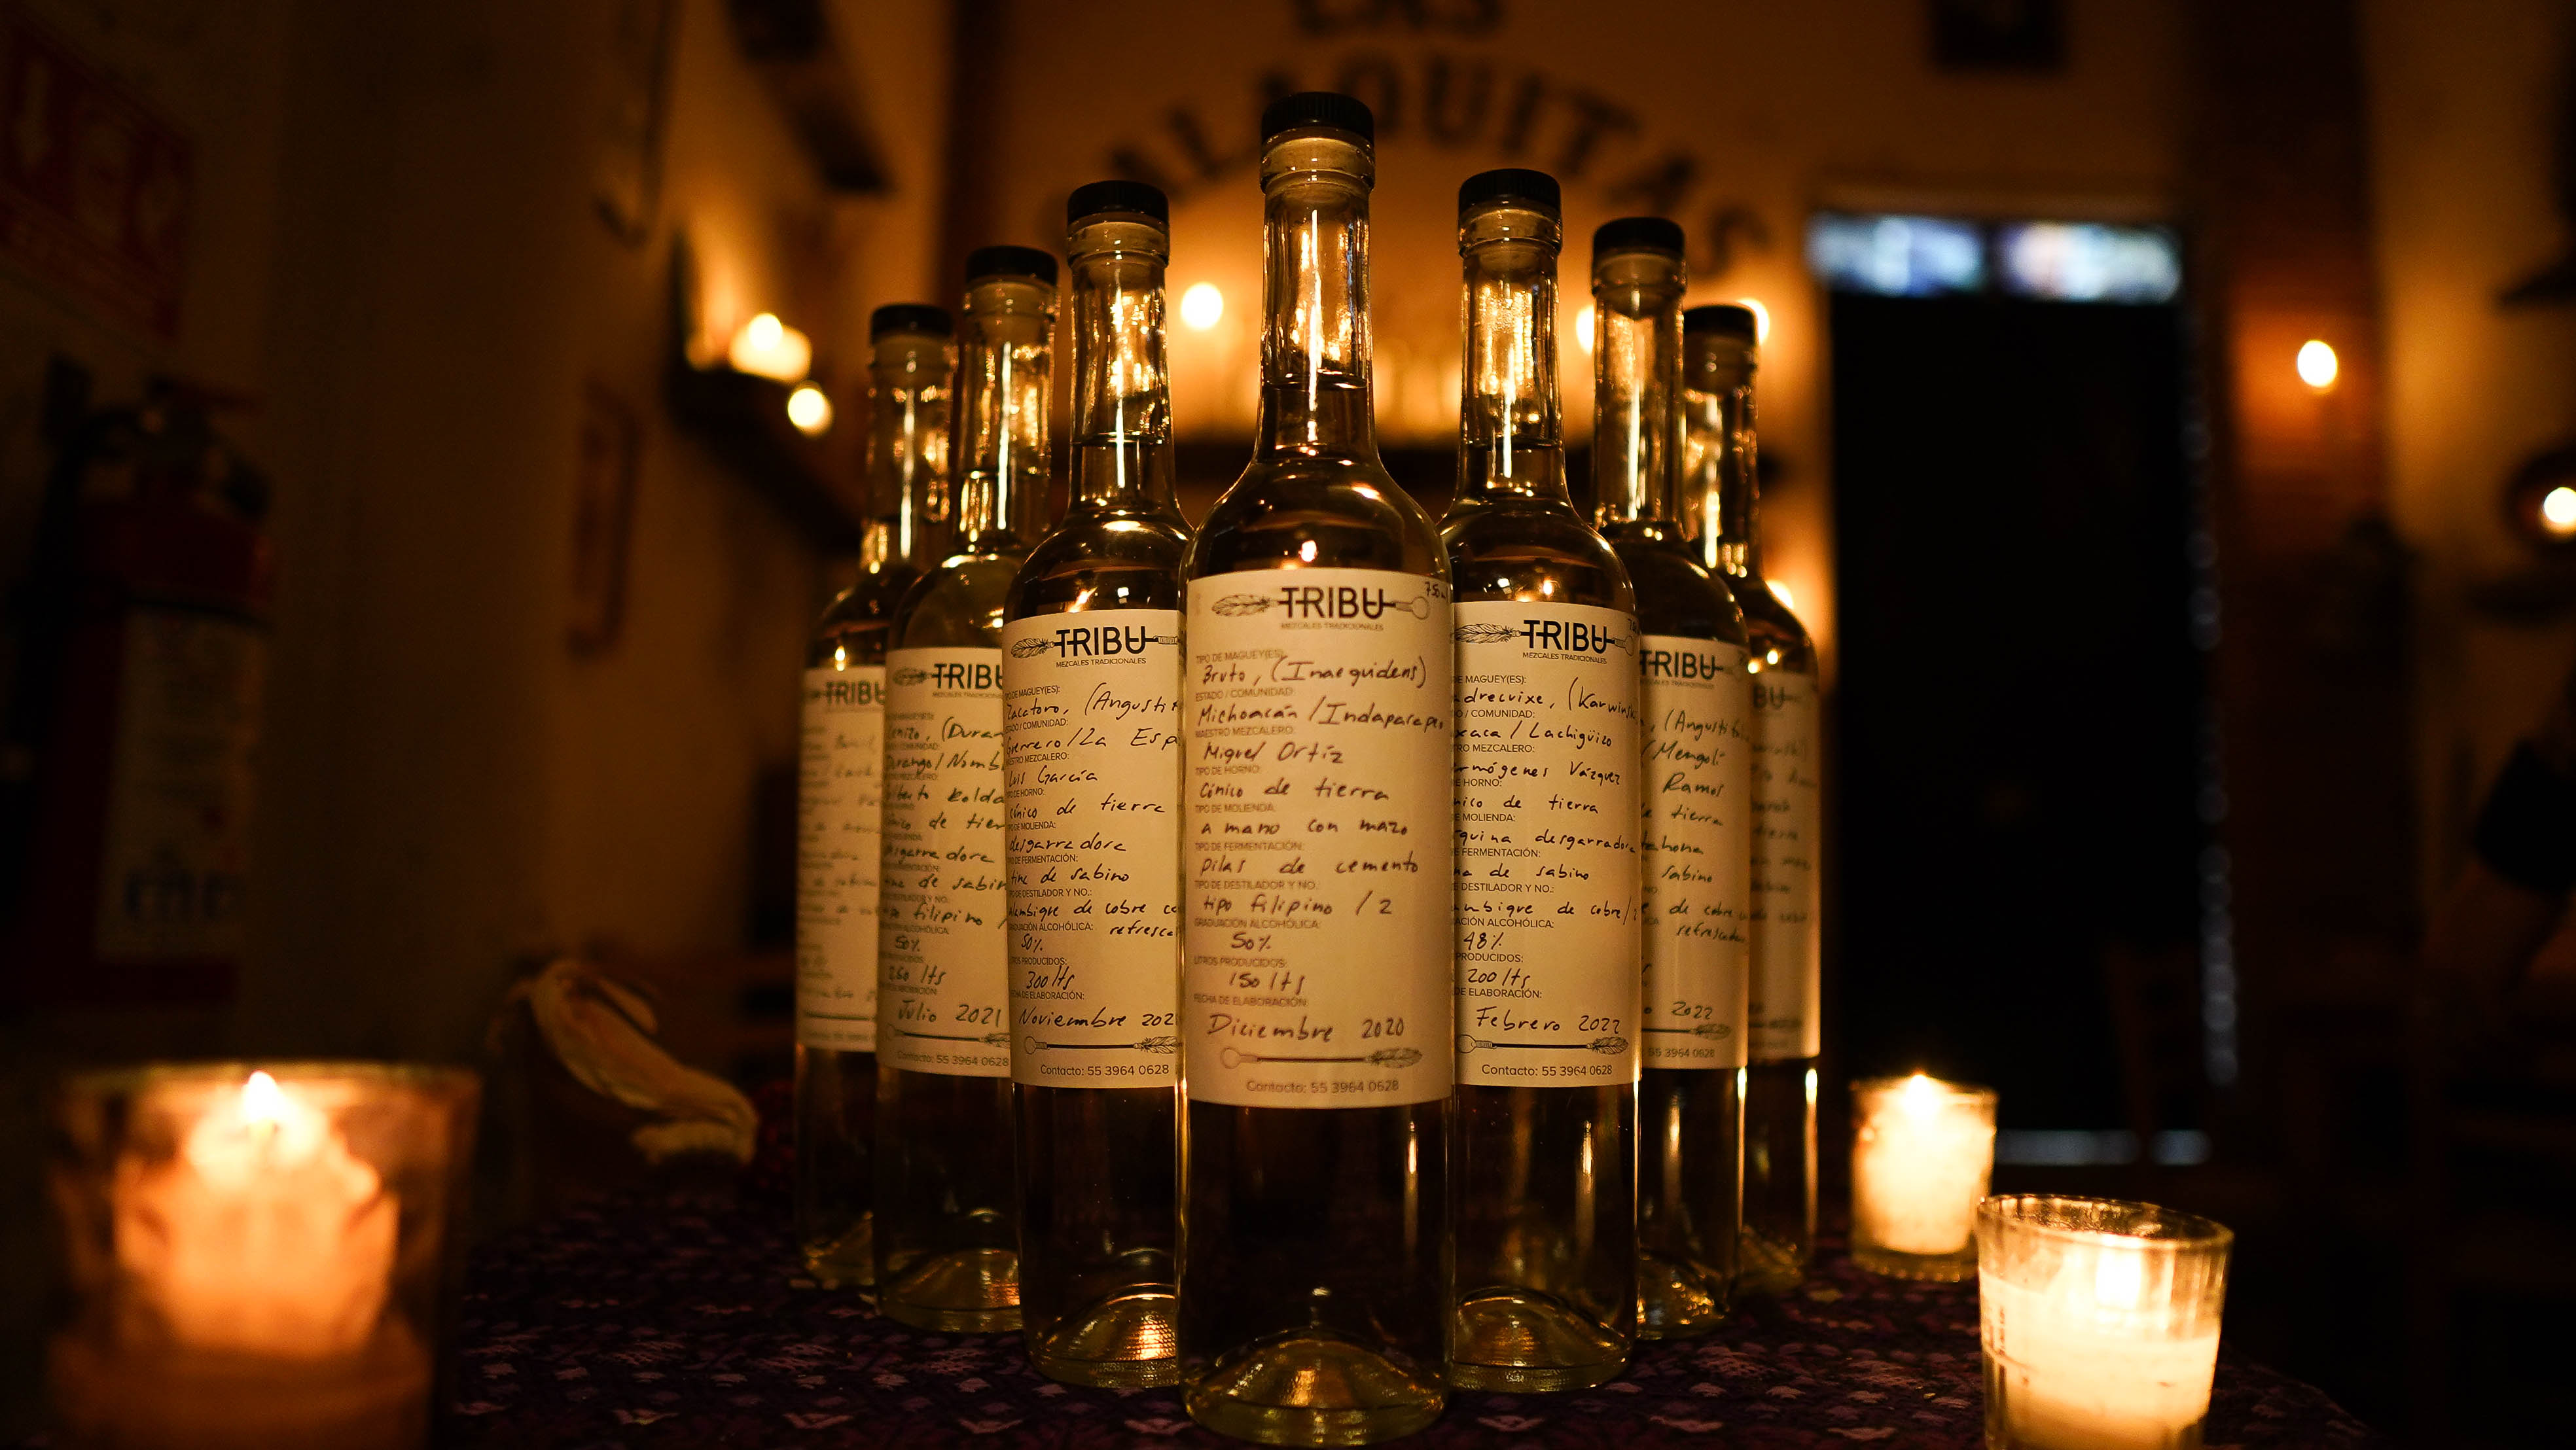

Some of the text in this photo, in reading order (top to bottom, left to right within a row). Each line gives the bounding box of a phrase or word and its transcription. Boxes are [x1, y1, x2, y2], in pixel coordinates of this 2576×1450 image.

[1281, 586, 1384, 619] TRIBU
[1056, 626, 1145, 658] TRIBU
[1523, 620, 1607, 654] TRIBU
[1056, 658, 1147, 668] MEZCALES TRADICIONALES
[1522, 652, 1607, 665] MEZCALES TRADICIONALES
[1639, 650, 1716, 680] TRIBU
[1465, 675, 1527, 684] MAGUEY(ES):
[1471, 709, 1535, 718] COMUNIDAD:
[1022, 718, 1069, 731] COMUNIDAD:
[1204, 741, 1267, 764] Miguel
[1473, 744, 1535, 752] MEZCALERO:
[1025, 752, 1070, 763] MEZCALERO:
[1037, 764, 1098, 785] García
[1263, 777, 1290, 796] de
[1315, 777, 1389, 801] tierra
[1463, 779, 1503, 787] HORNO:
[1056, 798, 1077, 816] de
[1503, 794, 1522, 809] de
[1548, 794, 1598, 814] tierra
[929, 811, 948, 830] de
[1462, 813, 1516, 822] MOLIENDA:
[1225, 822, 1280, 837] mano
[1308, 819, 1339, 834] con
[1359, 818, 1408, 836] mazo
[1022, 853, 1079, 864] FERMENTACIÓN:
[1461, 847, 1541, 858] FERMENTACIÓN:
[1200, 850, 1419, 877] pilas de cemento
[1490, 862, 1510, 878] de
[1536, 864, 1589, 880] sabino
[919, 873, 939, 888] de
[1040, 866, 1057, 883] de
[1070, 862, 1130, 883] sabino
[1022, 889, 1064, 898] DESTILADOR
[1461, 883, 1522, 893] DESTILADOR
[1526, 884, 1532, 893] Y
[1073, 899, 1147, 915] de cobre
[1204, 895, 1232, 916] tipo
[1251, 893, 1334, 917] filipino
[1379, 899, 1393, 915] 2
[1557, 902, 1575, 915] de
[1669, 898, 1689, 915] de
[1039, 920, 1094, 931] ALCOHÓLICA:
[1487, 917, 1554, 929] ALCOHÓLICA:
[1021, 933, 1043, 953] 50%
[1230, 932, 1272, 953] 50%
[1463, 931, 1504, 951] 48%
[1021, 957, 1067, 966] PRODUCIDOS:
[1456, 952, 1524, 963] PRODUCIDOS:
[1026, 964, 1075, 991] 300 lts
[1467, 968, 1531, 989] 200 lts
[1029, 989, 1084, 1000] ELABORACIÓN:
[1469, 988, 1542, 999] ELABORACIÓN:
[956, 1004, 1001, 1027] 2021
[1018, 1006, 1127, 1028] Noviembre
[1671, 1000, 1713, 1019] 2022
[1207, 1013, 1404, 1042] Diciembre 2020
[1476, 1006, 1621, 1034] Febrero 2022
[937, 1055, 949, 1065] 55
[952, 1055, 978, 1065] 3964
[982, 1057, 1009, 1066] 0628
[1041, 1064, 1170, 1076] Contacto: 55 3964 0628
[1482, 1064, 1613, 1076] Contacto: 55 3964 0628
[1246, 1080, 1399, 1093] Contacto: 55 3964 0628
